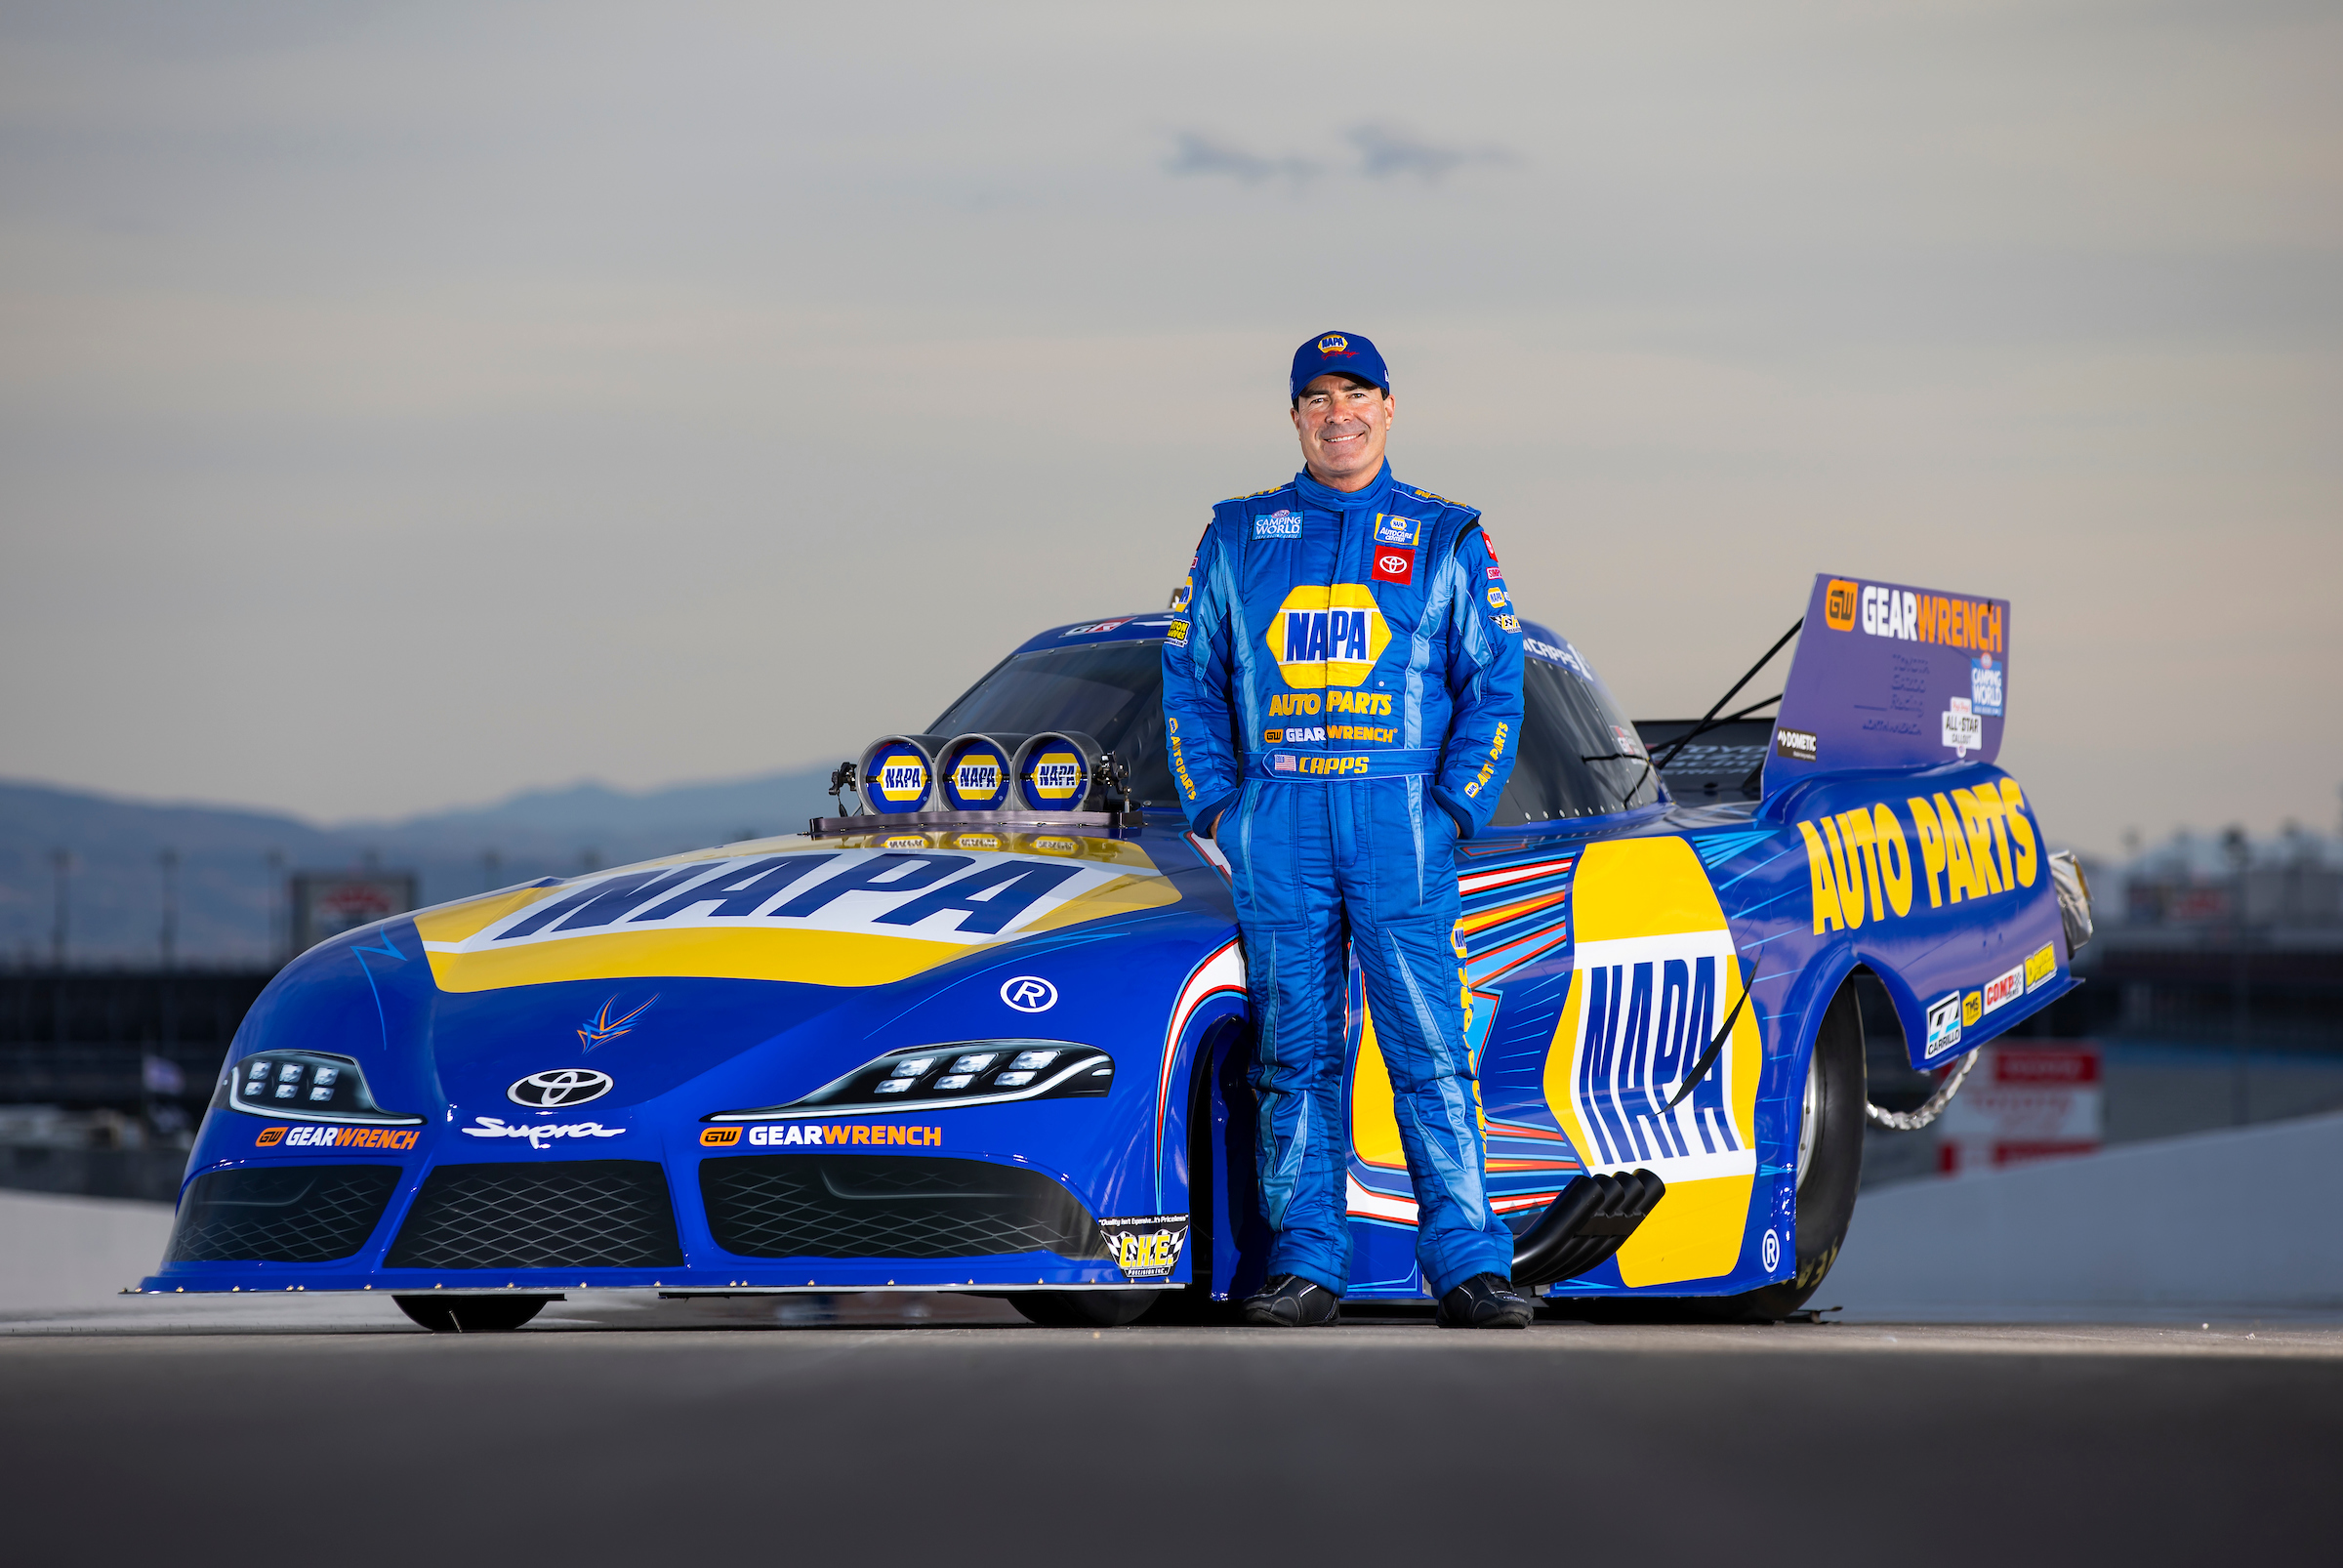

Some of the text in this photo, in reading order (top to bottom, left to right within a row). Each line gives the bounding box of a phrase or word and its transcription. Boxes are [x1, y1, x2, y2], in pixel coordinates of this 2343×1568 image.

[1322, 338, 1344, 348] NAPA
[1256, 516, 1301, 527] CAMPING
[1256, 524, 1300, 535] WORLD
[1379, 527, 1413, 540] AUTOCARE
[1862, 586, 2002, 653] GEARWRENCH
[1286, 610, 1368, 662] NAPA
[1972, 668, 2001, 688] CAMPING
[1269, 690, 1392, 717] AUTO PARTS
[1972, 684, 2002, 707] WORLD
[1787, 731, 1817, 752] DOMETIC
[960, 766, 996, 787] NAPA
[1039, 764, 1075, 786] NAPA
[1299, 757, 1369, 774] CAPPS
[885, 767, 921, 788] NAPA
[1796, 777, 2037, 935] AUTO PARTS
[493, 852, 1087, 941] NAPA
[1987, 974, 2014, 1007] COMP
[1965, 996, 1979, 1014] TMS
[1928, 1029, 1960, 1055] CARRILLO
[1579, 956, 1740, 1166] NAPA
[259, 1127, 421, 1150] GW GEARWRENCH
[462, 1117, 627, 1150] Supra
[704, 1125, 942, 1146] GW GEARWRENCH
[1119, 1235, 1173, 1267] C.H.E.
